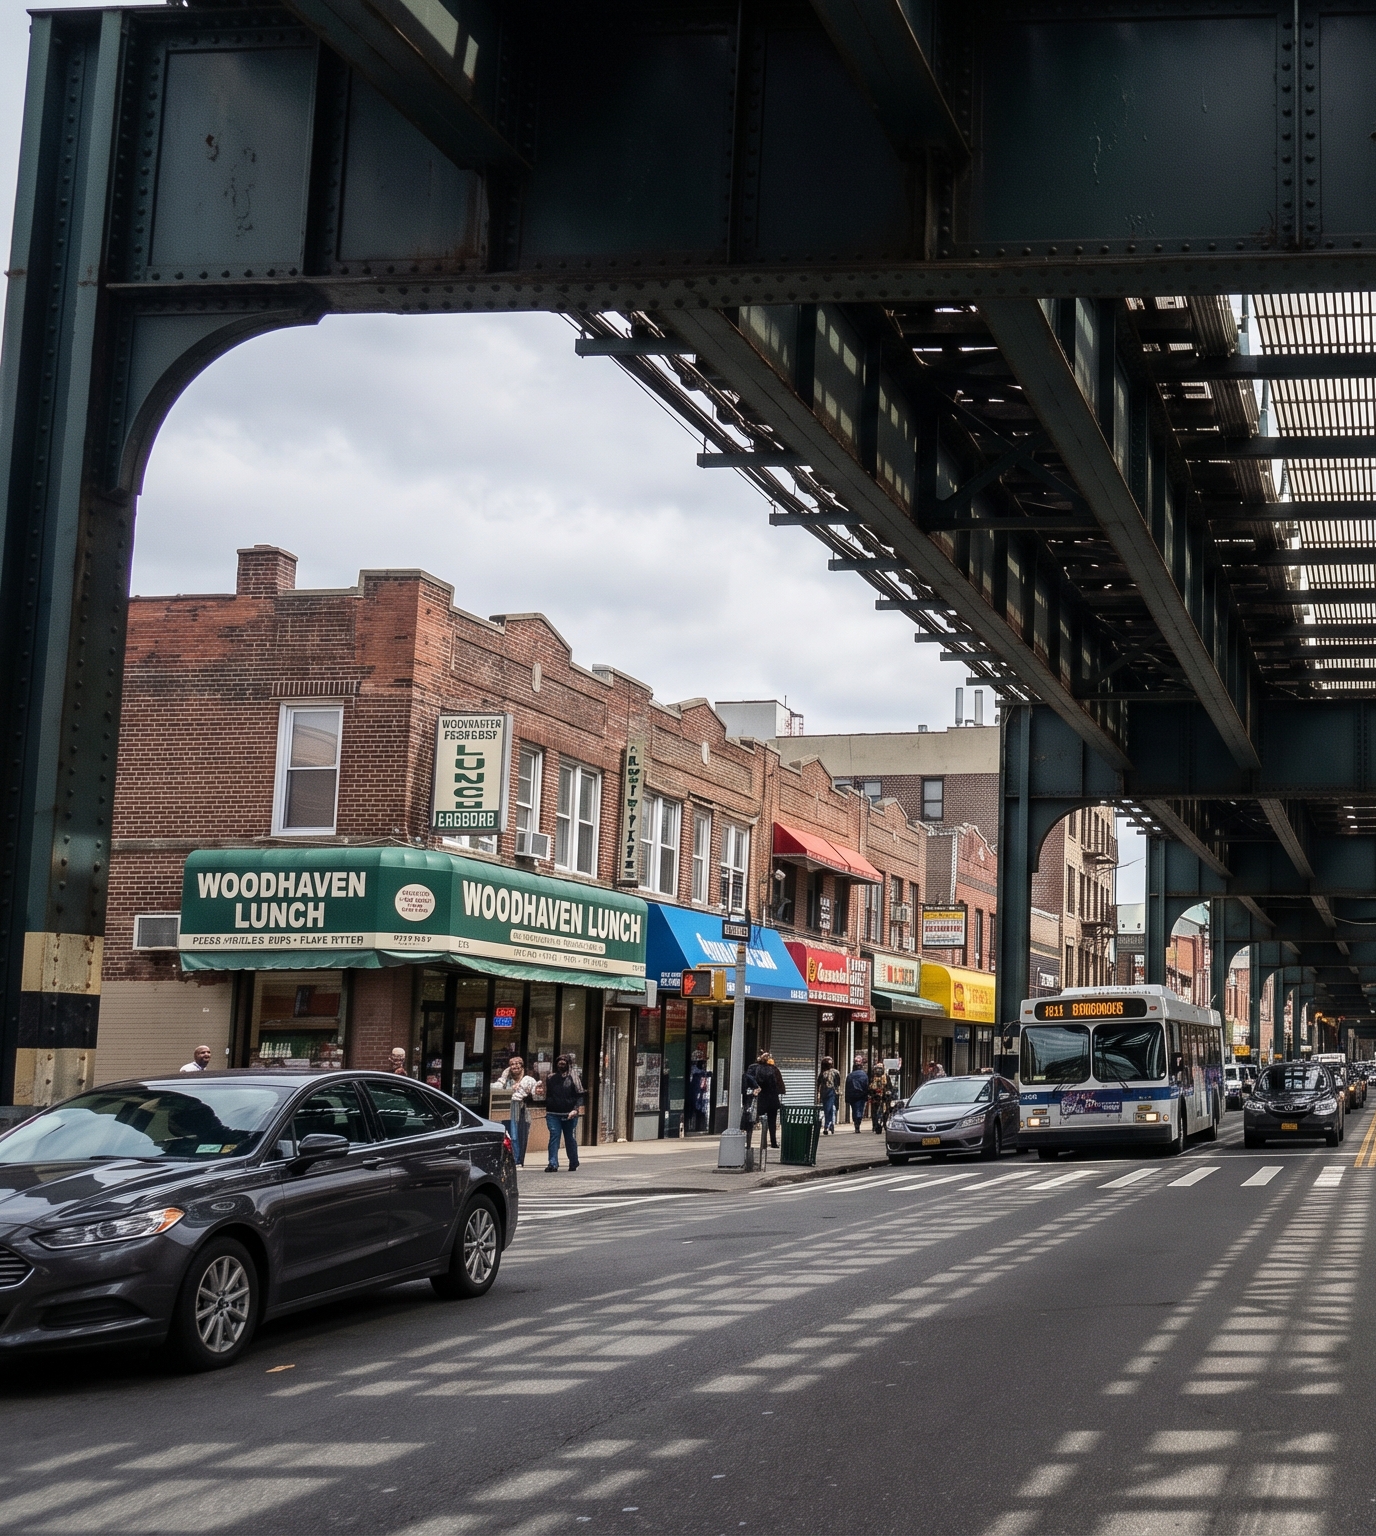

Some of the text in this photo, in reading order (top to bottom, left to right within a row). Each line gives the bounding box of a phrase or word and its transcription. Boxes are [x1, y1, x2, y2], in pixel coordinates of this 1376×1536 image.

[197, 871, 367, 899] WOODHAVEN
[234, 902, 325, 928] LUNCH
[462, 880, 583, 935] WOODHAVEN
[588, 906, 642, 944] LUNCH
